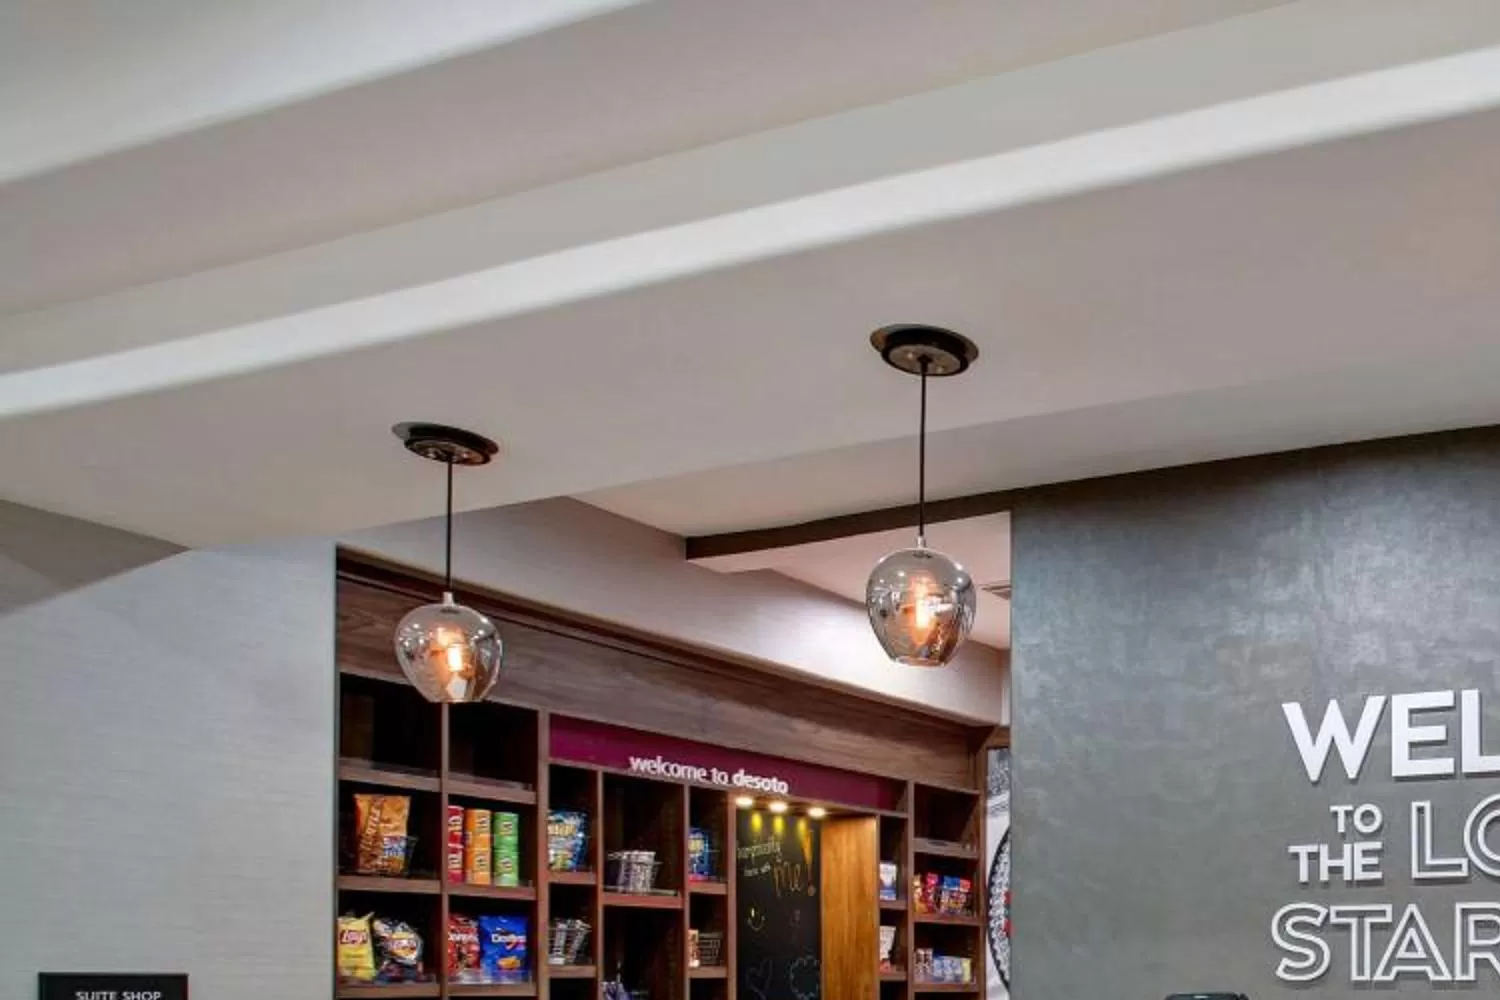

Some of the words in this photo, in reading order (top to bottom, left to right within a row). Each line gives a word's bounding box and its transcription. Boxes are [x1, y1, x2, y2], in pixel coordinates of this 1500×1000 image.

[628, 755, 708, 782] welcome
[710, 767, 729, 786] to
[732, 768, 789, 795] desoto
[1330, 803, 1383, 835] TO
[1288, 841, 1384, 884] THE
